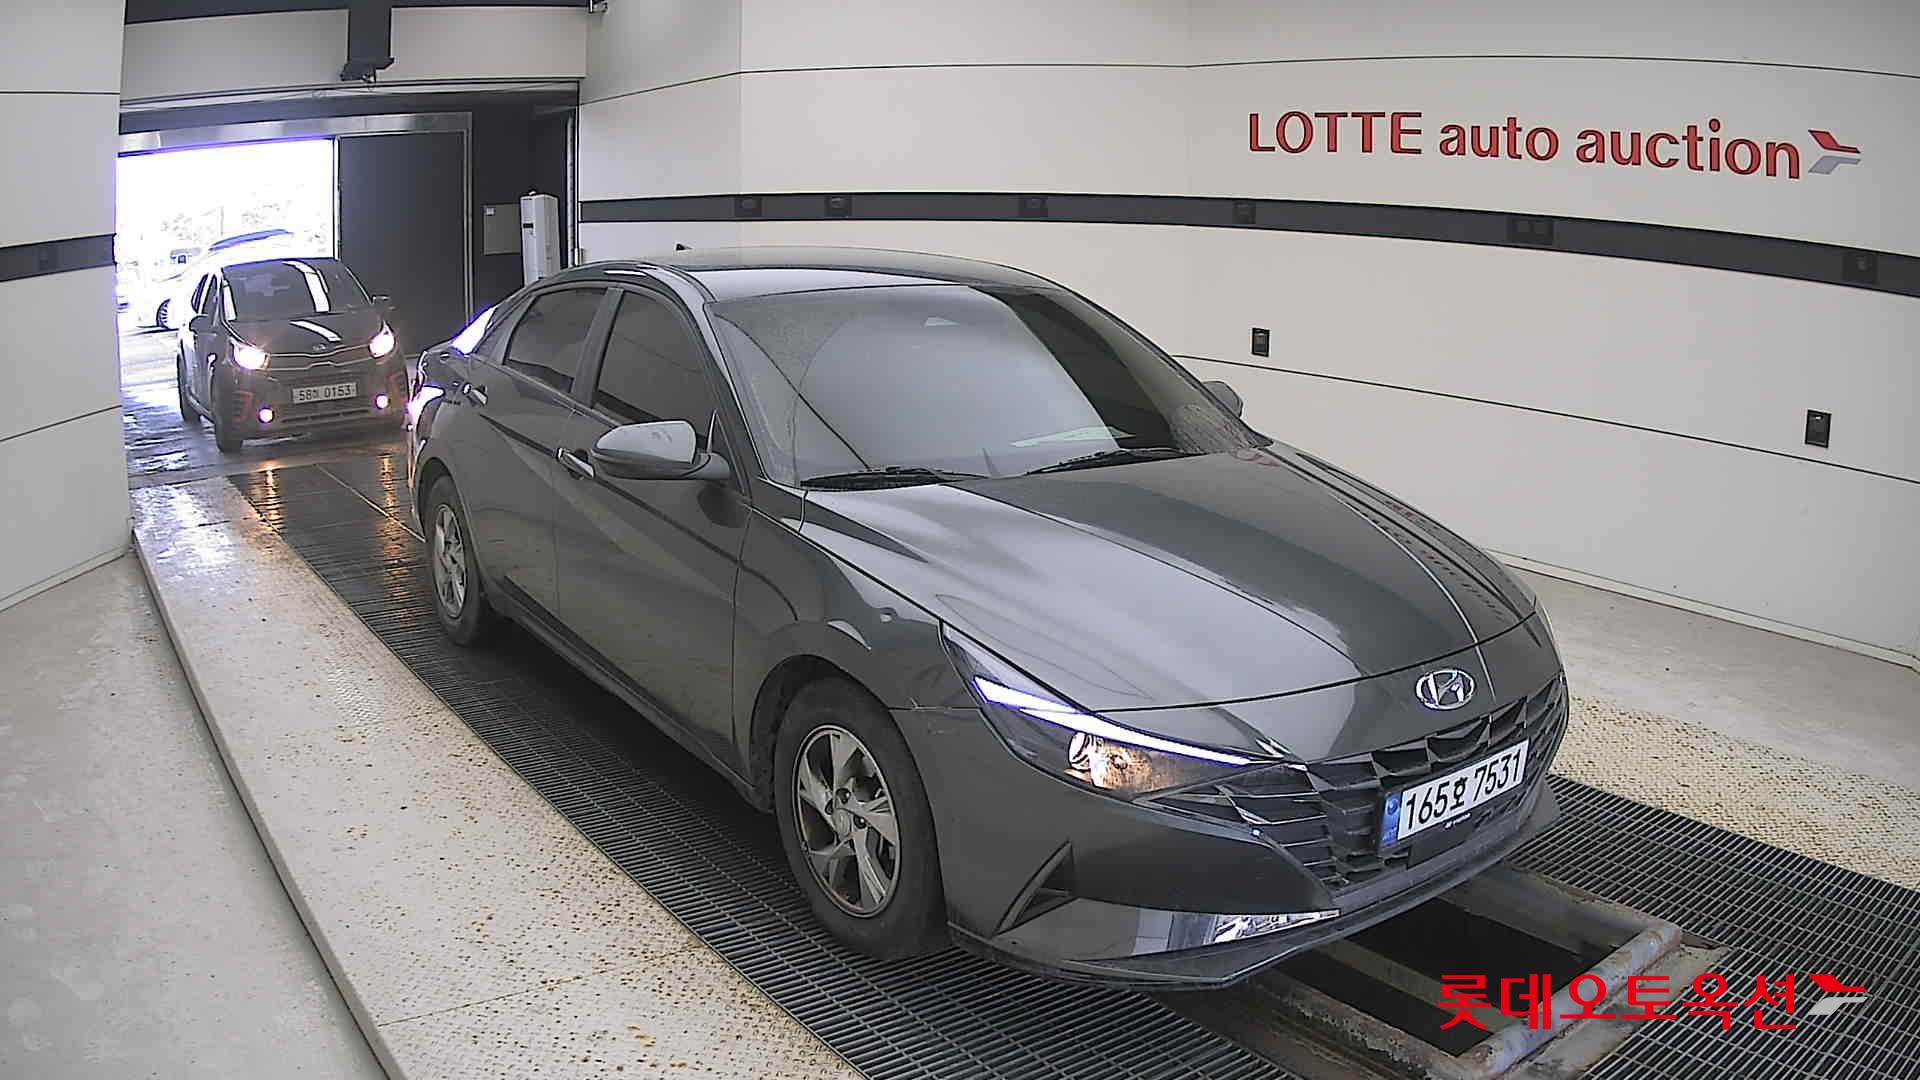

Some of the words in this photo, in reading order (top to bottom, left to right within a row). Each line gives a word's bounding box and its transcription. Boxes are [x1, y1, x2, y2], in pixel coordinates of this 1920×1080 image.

[1249, 111, 1422, 155] LOTTE
[1439, 117, 1559, 161] auto
[1576, 119, 1801, 179] auction
[324, 384, 351, 398] 0153
[1406, 776, 1468, 830] 165호
[1473, 749, 1521, 802] 7531
